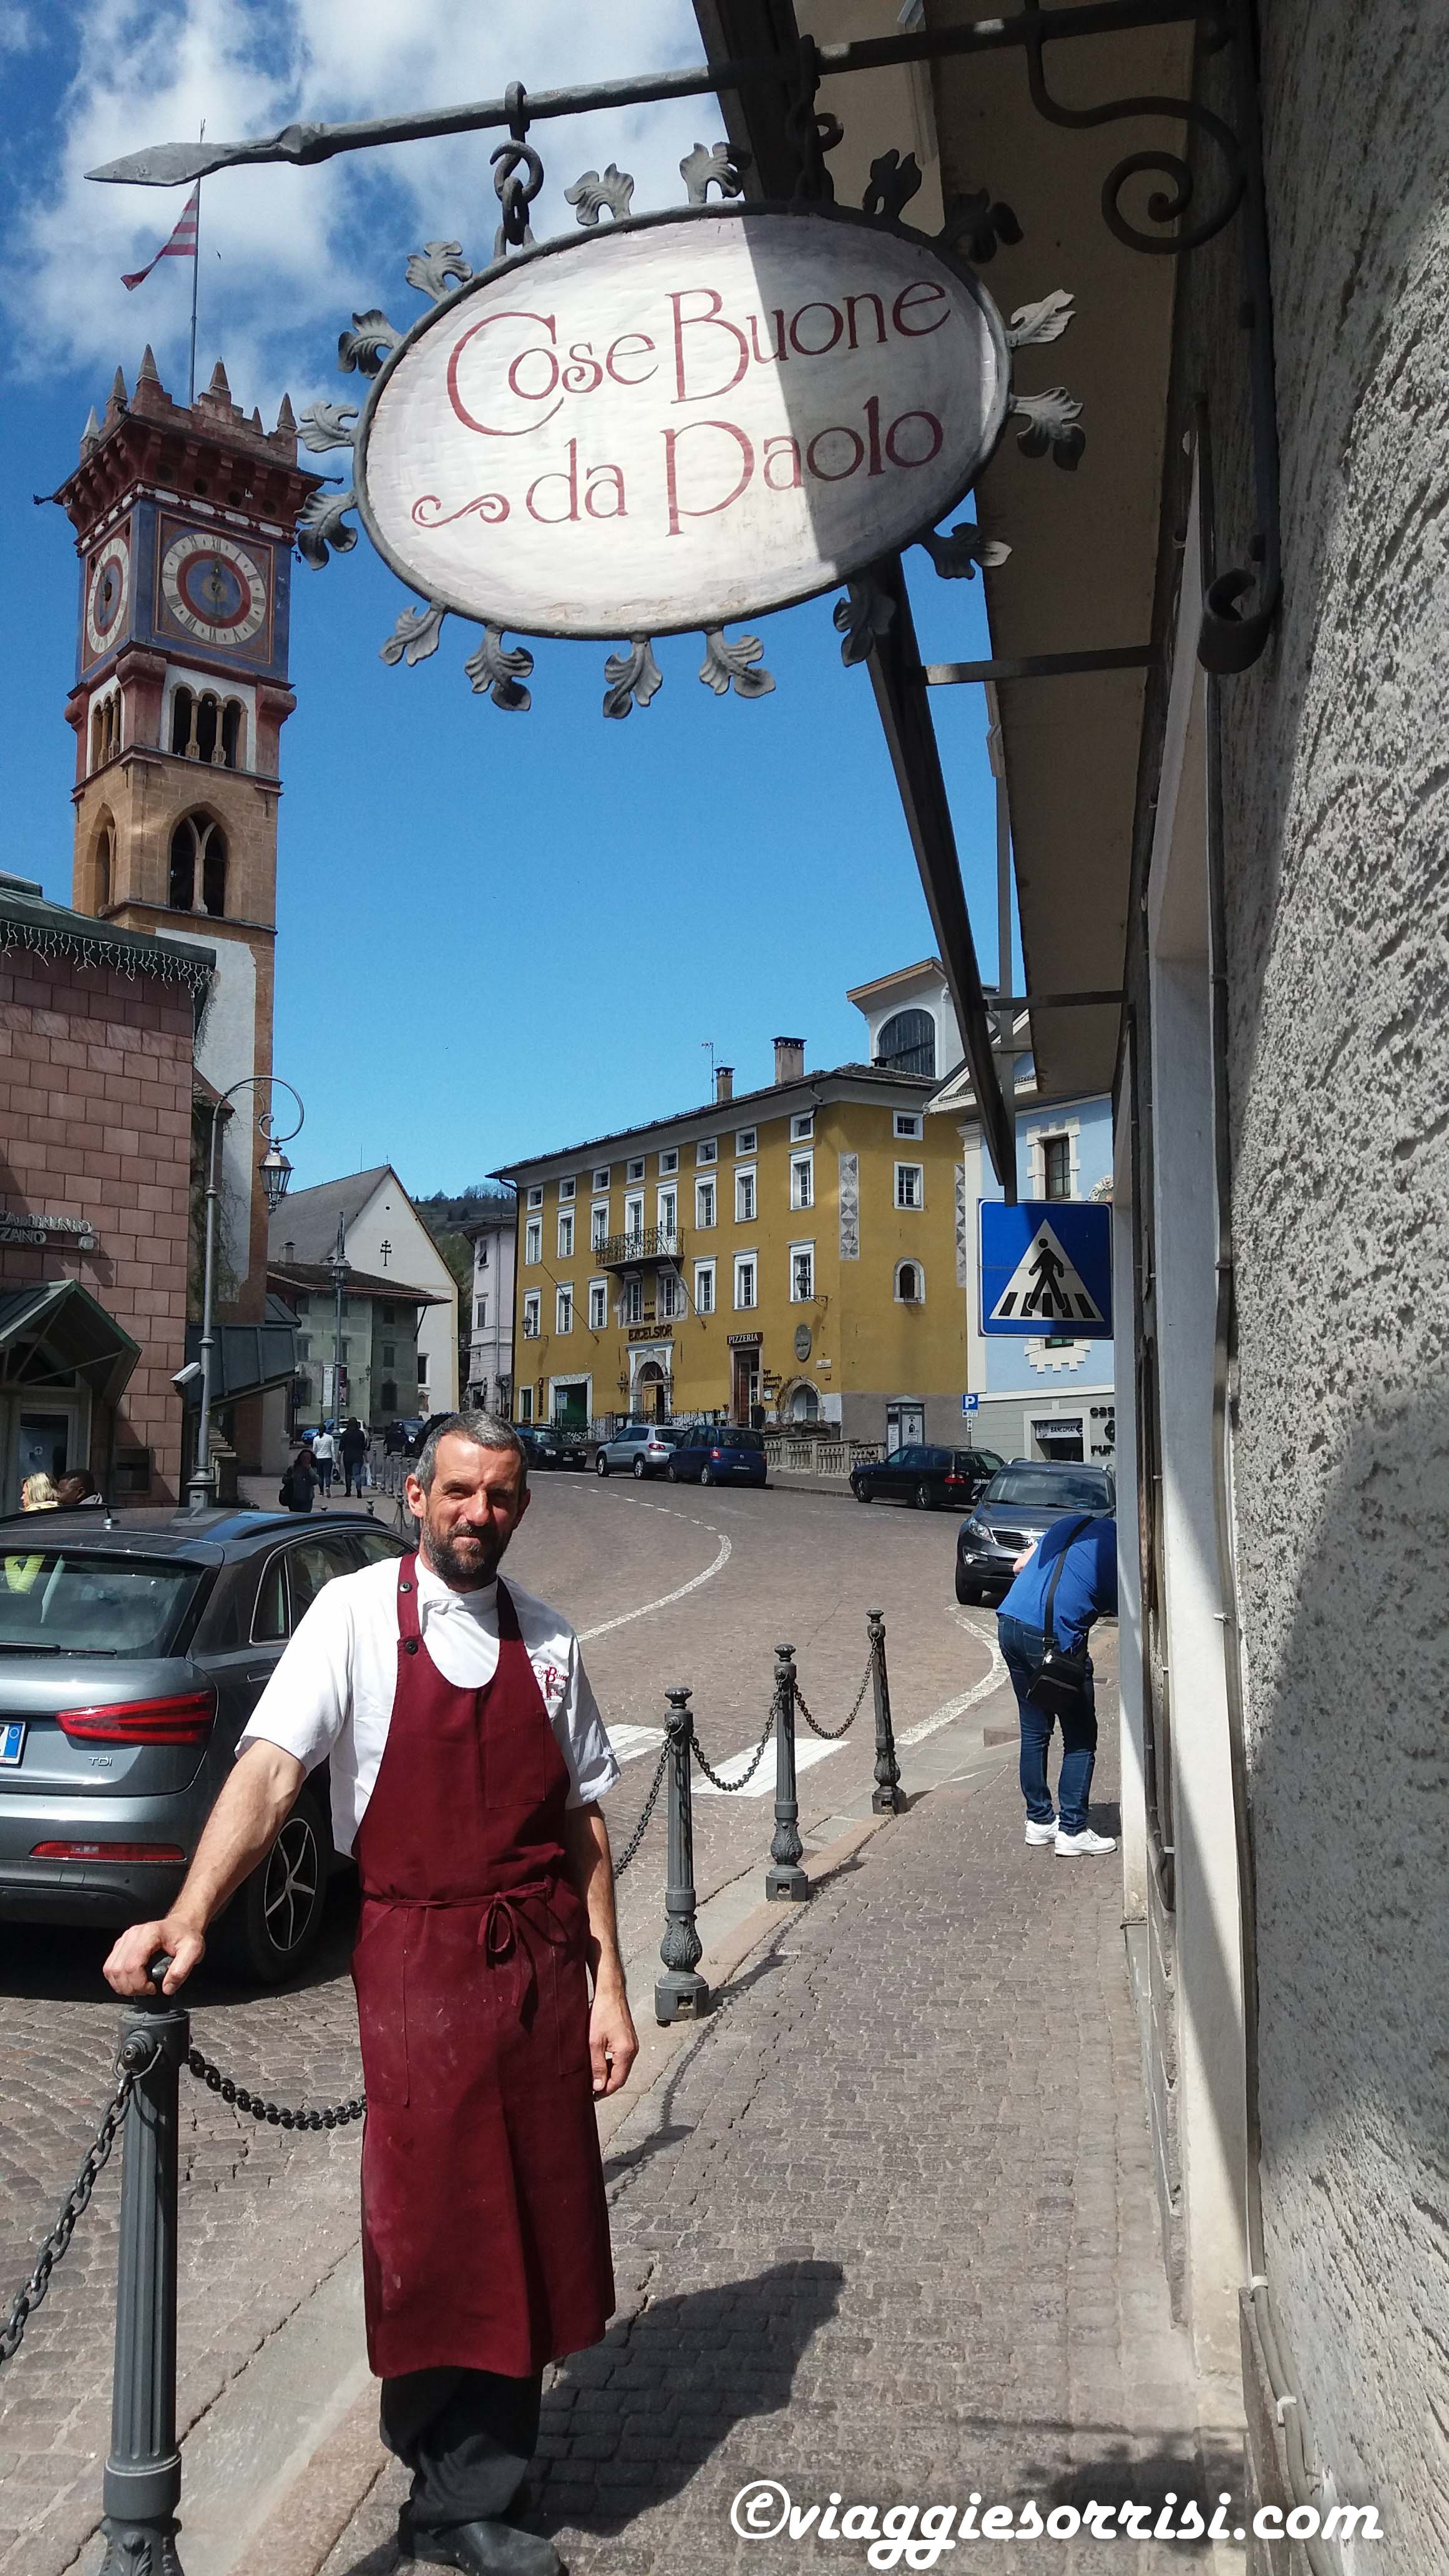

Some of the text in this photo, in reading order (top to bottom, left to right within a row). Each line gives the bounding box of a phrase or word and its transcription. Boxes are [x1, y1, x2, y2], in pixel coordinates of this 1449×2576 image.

[447, 281, 951, 436] Cose Buone
[525, 396, 944, 537] da Paolo
[628, 1324, 673, 1342] EXCELSIOR
[728, 1333, 758, 1344] PIZZERIA
[965, 1395, 975, 1408] P
[88, 1757, 113, 1767] TDI
